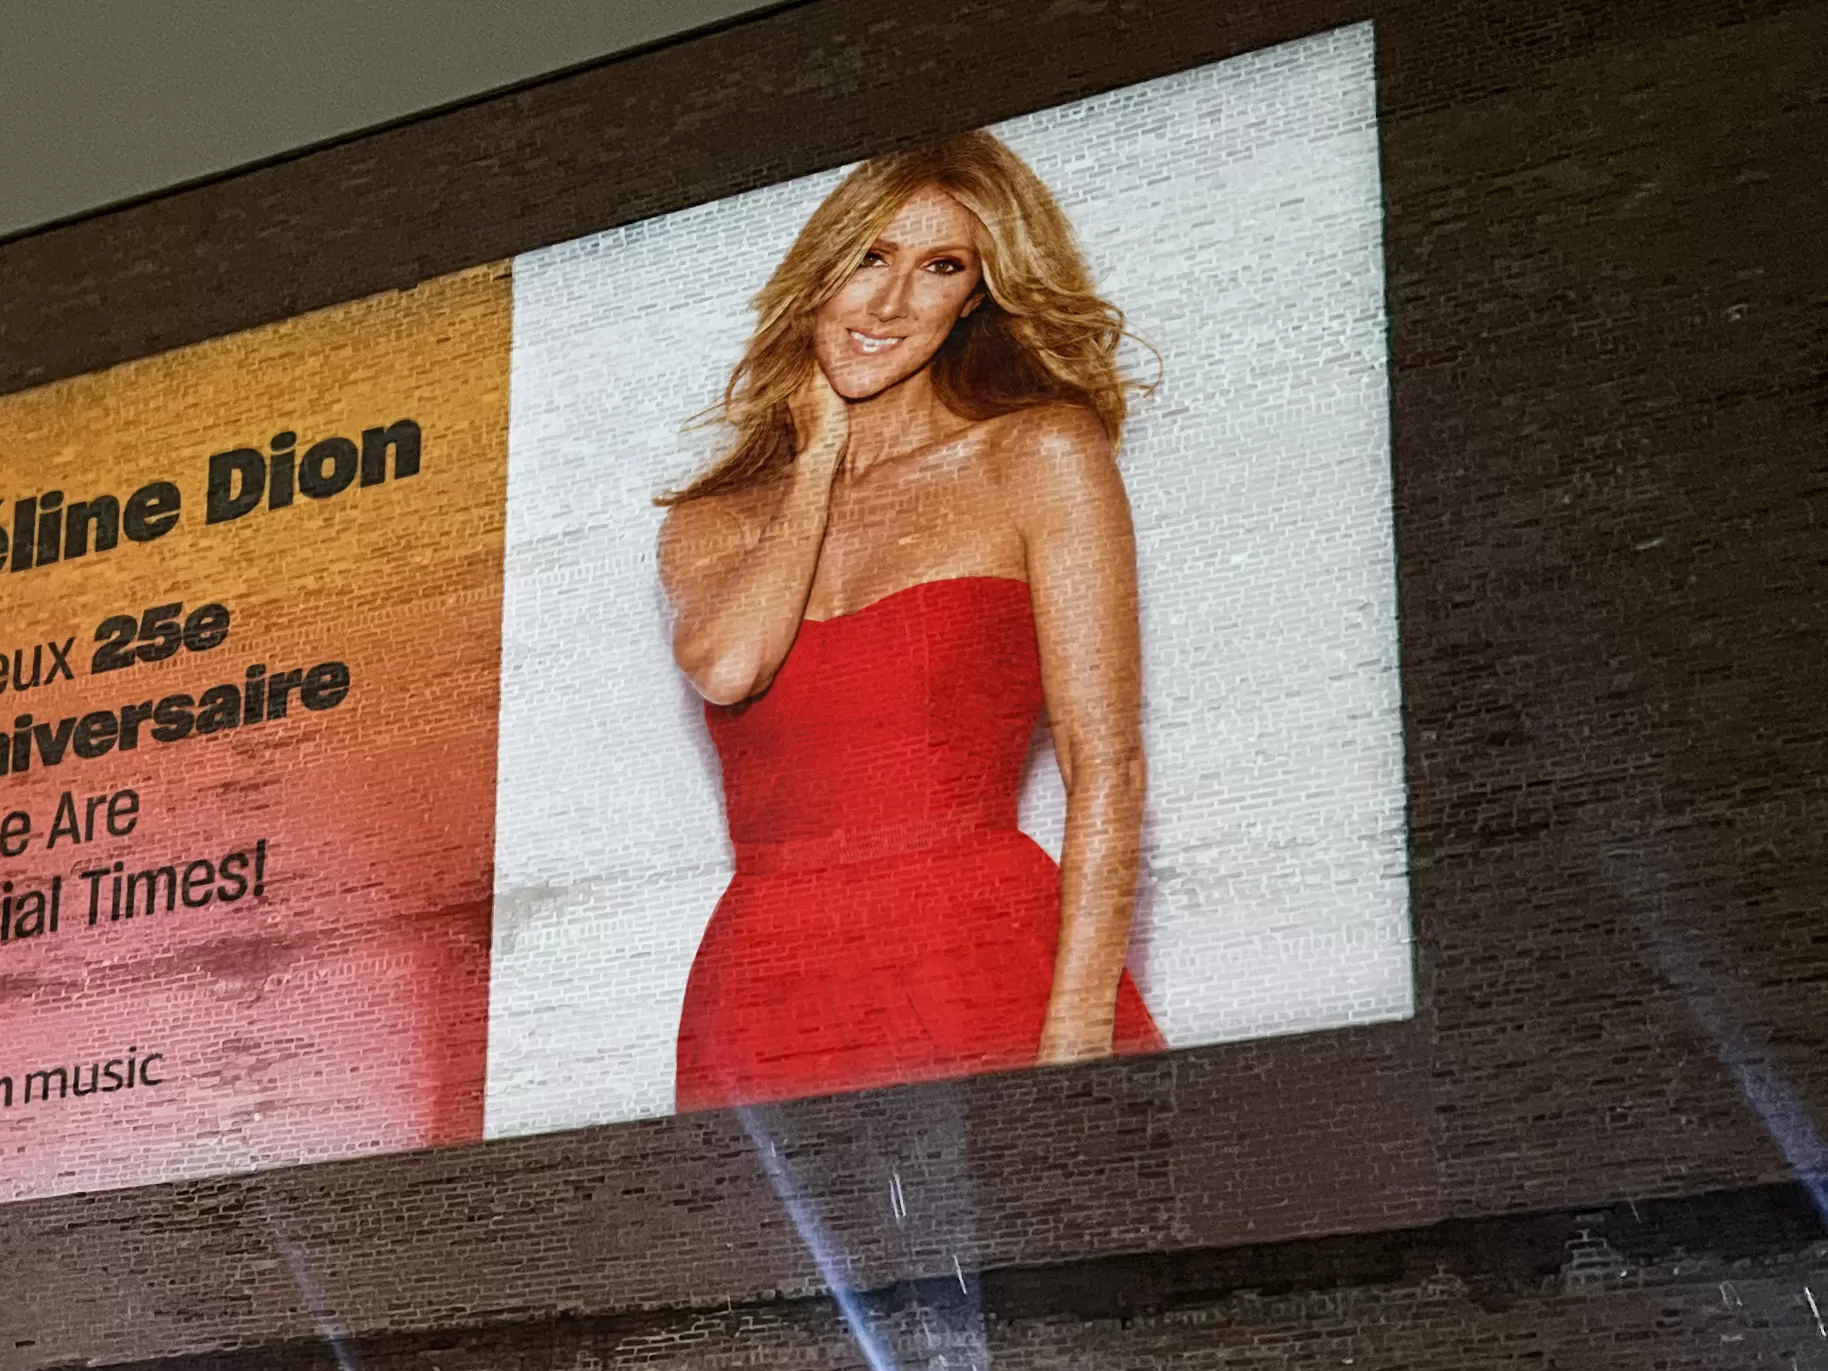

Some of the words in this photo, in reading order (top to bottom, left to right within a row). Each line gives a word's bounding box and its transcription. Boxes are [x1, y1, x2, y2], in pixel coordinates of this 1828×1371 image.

[205, 418, 421, 525] Dion
[91, 601, 231, 675] 25e
[46, 787, 140, 850] Are
[81, 839, 268, 926] Times!
[23, 1046, 165, 1104] music
